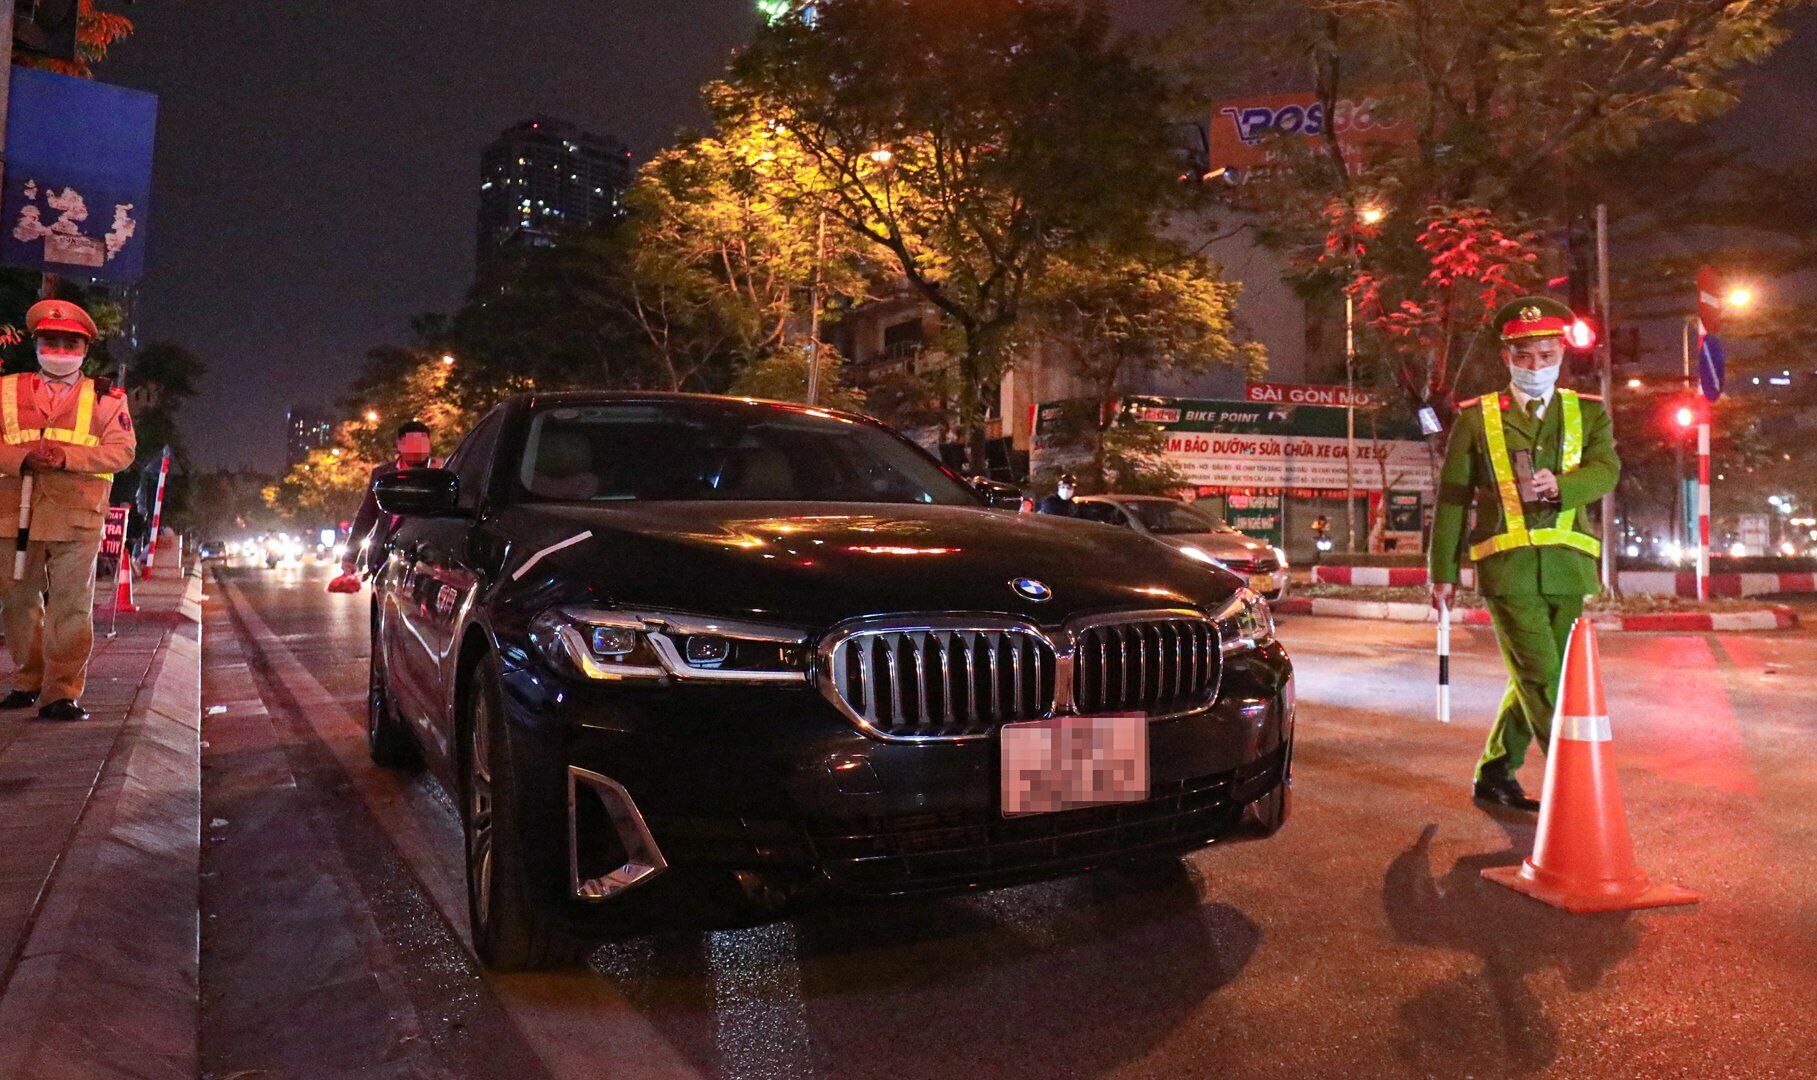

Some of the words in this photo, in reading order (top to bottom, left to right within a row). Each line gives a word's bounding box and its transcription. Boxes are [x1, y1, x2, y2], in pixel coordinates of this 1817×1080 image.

[1251, 384, 1283, 400] SÀI
[1289, 387, 1333, 403] GÒN
[1185, 411, 1217, 421] BIKE
[1220, 412, 1260, 423] POINT
[1184, 435, 1209, 453] BẢO
[1259, 438, 1281, 456] SỬA
[1316, 445, 1331, 457] XE
[1332, 446, 1349, 458] GA
[1356, 446, 1370, 459] XE
